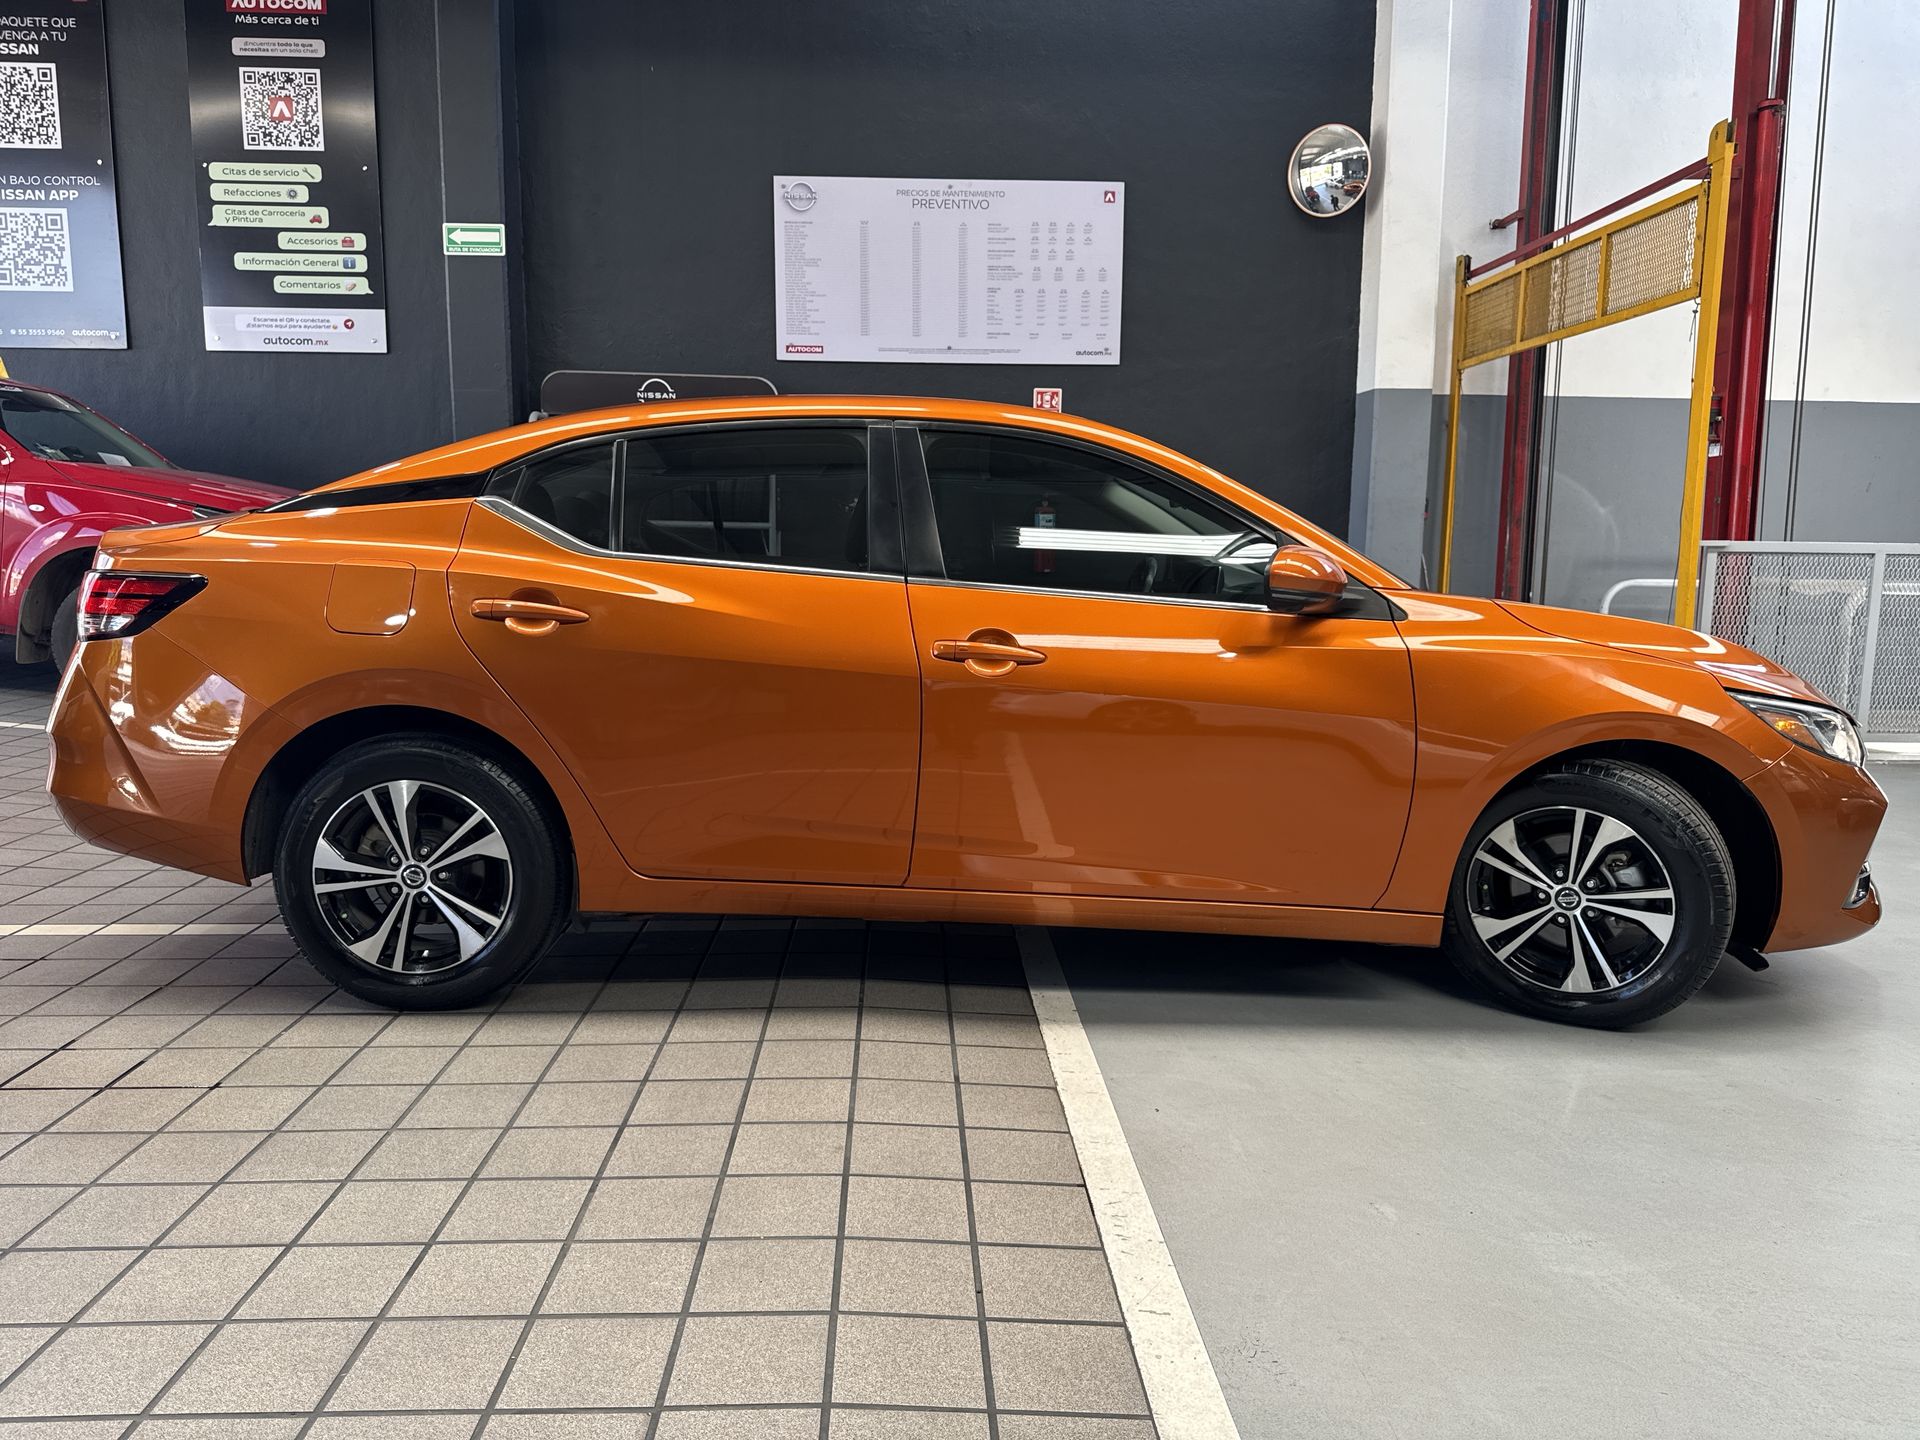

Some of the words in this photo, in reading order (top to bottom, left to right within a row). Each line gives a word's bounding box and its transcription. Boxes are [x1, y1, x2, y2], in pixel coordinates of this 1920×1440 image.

[232, 0, 322, 10] AUTOCOM
[0, 16, 49, 28] AQUETE
[51, 18, 76, 28] QUE
[235, 15, 258, 24] Más
[294, 16, 309, 25] de
[311, 16, 319, 25] ti
[40, 31, 49, 41] A
[50, 31, 67, 41] TU
[222, 168, 246, 176] Citas
[249, 168, 261, 176] de
[263, 168, 299, 177] servicio
[10, 175, 40, 185] BAJO
[44, 176, 101, 186] CONTROL
[49, 190, 79, 201] APP
[224, 188, 281, 197] Refacciones
[912, 199, 990, 209] PREVENTIVO
[261, 209, 305, 217] Carrocería
[287, 237, 338, 245] Accesorios
[242, 257, 300, 266] Información
[279, 281, 341, 289] Comentarios
[264, 336, 328, 346] autocom.mx
